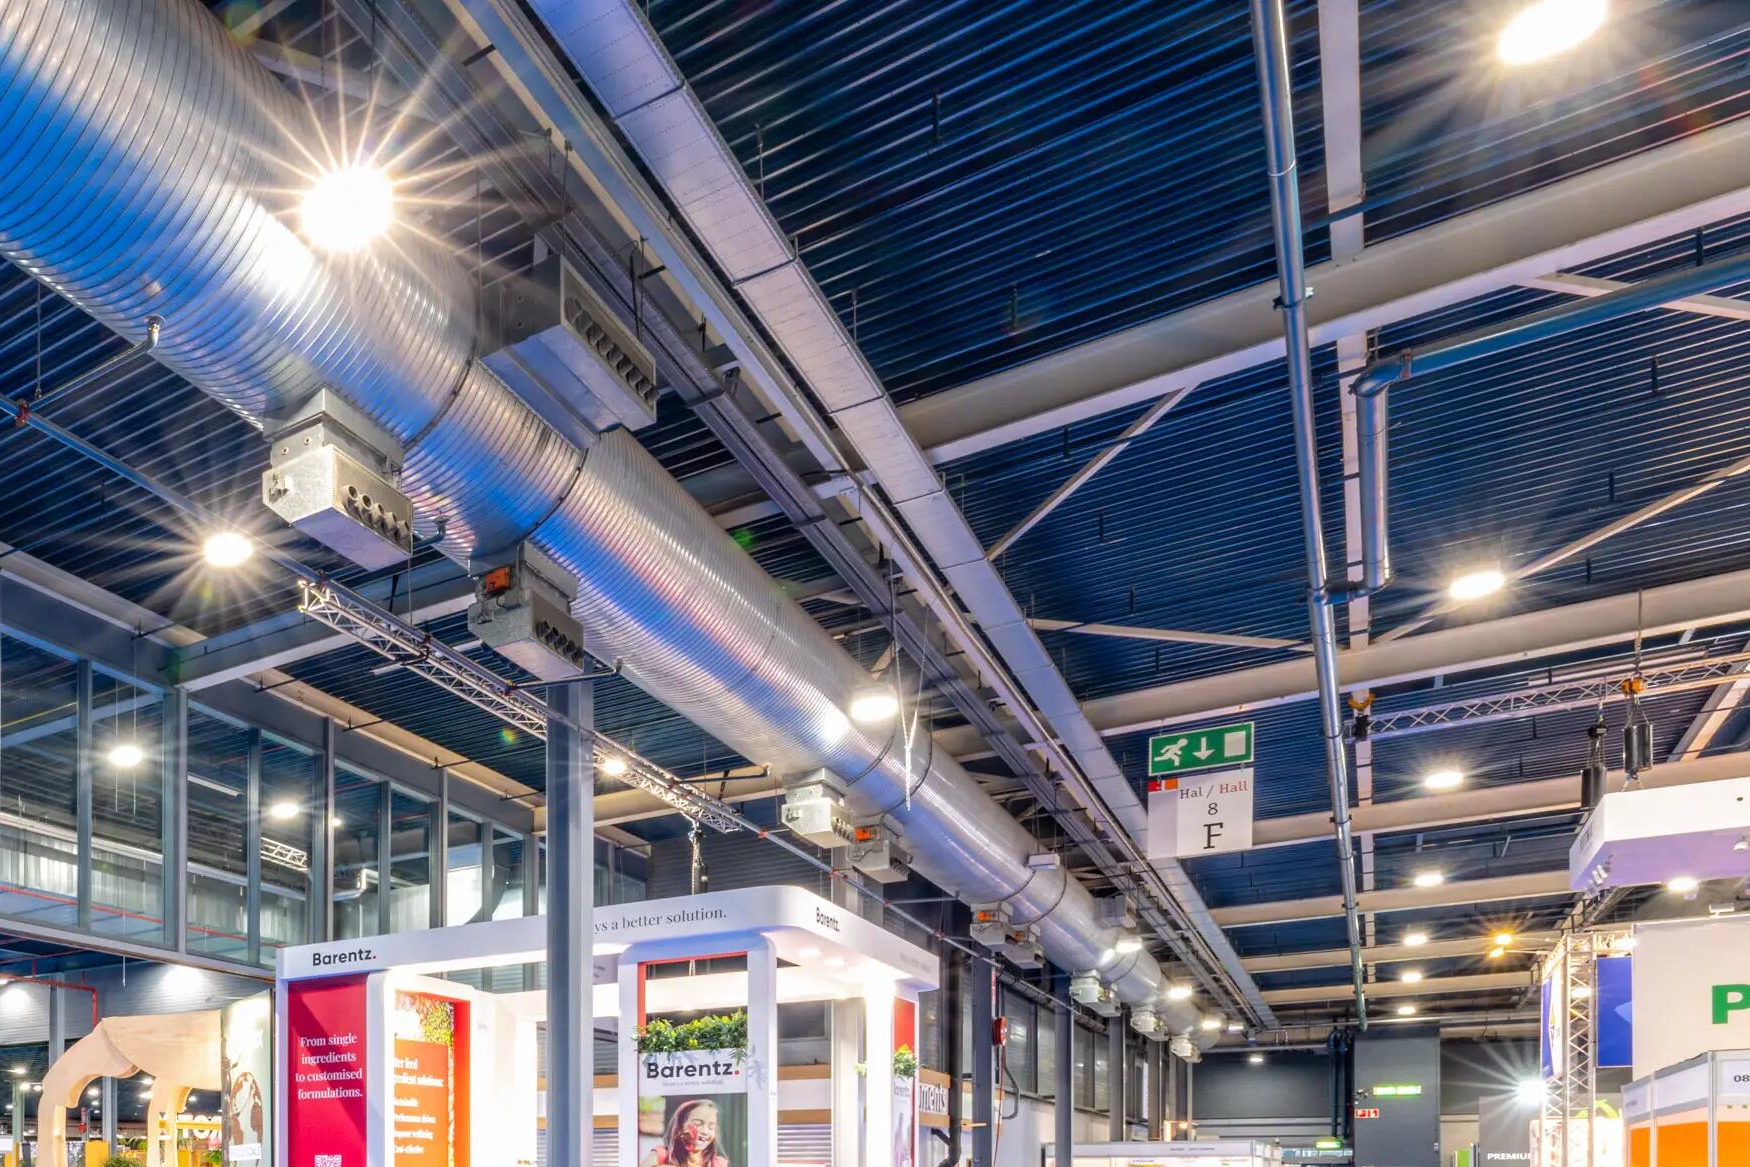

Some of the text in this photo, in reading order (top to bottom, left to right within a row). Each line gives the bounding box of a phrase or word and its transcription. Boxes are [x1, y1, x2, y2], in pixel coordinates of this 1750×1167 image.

[1180, 787, 1203, 800] Hal
[1220, 781, 1249, 794] Hall
[1208, 803, 1218, 815] 8
[1203, 822, 1224, 850] F
[611, 920, 619, 930] a
[623, 915, 663, 929] better
[666, 907, 727, 923] solution.
[312, 948, 377, 967] Barentz.
[300, 1032, 358, 1048] From single
[301, 1052, 356, 1066] ingredients
[295, 1068, 363, 1083] to customised
[646, 1061, 740, 1079] Barentz.
[297, 1087, 363, 1100] formulations.
